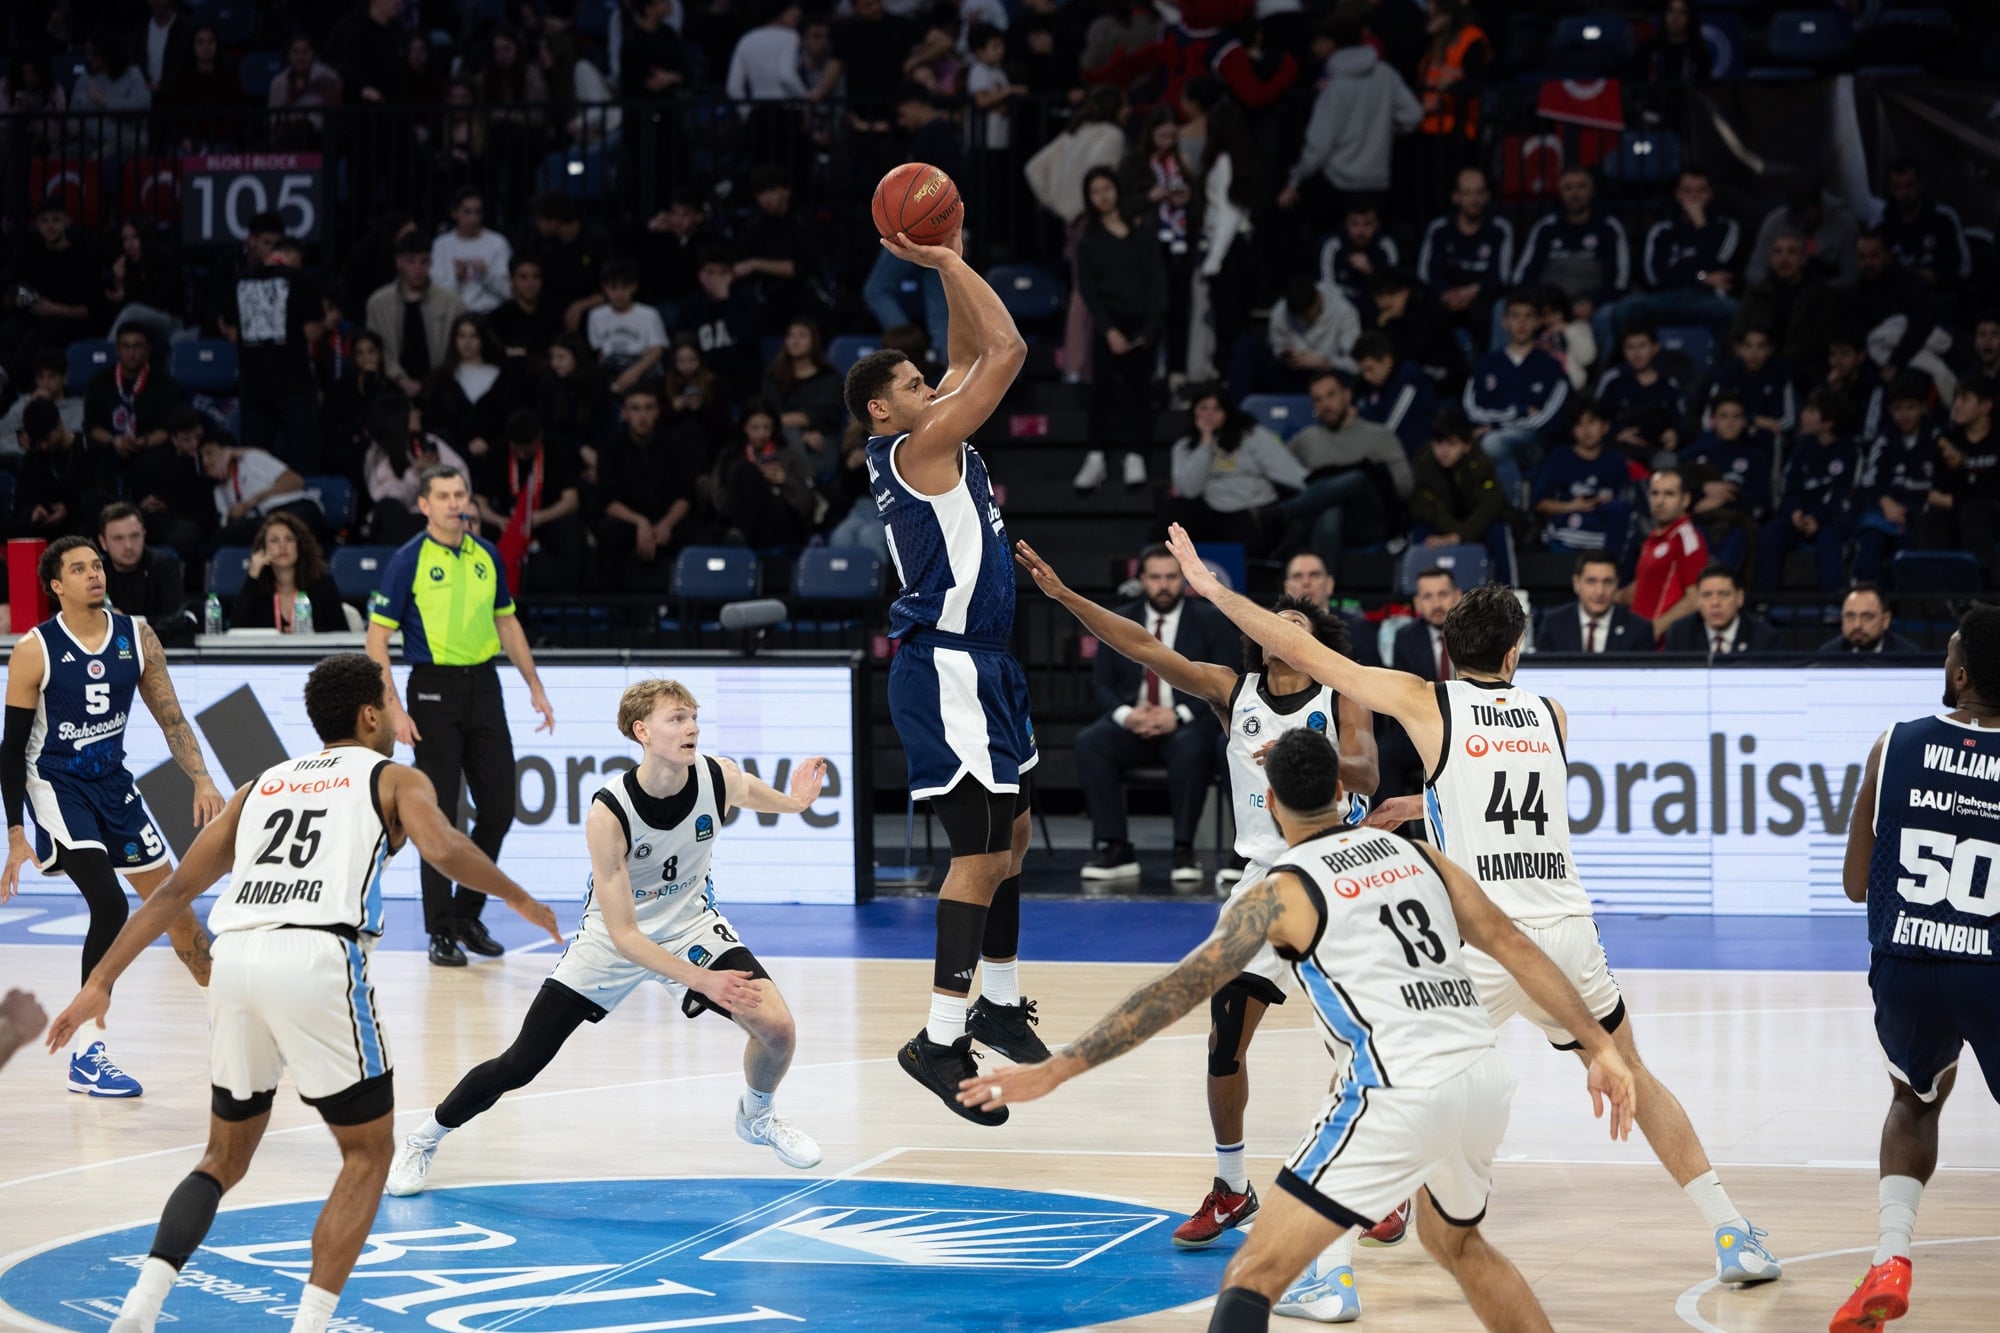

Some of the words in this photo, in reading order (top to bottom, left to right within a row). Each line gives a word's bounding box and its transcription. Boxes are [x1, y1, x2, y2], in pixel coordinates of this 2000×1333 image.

[192, 174, 315, 240] 105
[85, 683, 110, 715] 5
[1492, 740, 1551, 753] VEOLIA
[1923, 743, 2000, 783] WILLIAM
[289, 777, 350, 794] VEOLIA
[1567, 732, 1862, 836] oralisv
[1909, 788, 1953, 811] BAU
[1485, 771, 1548, 835] 44
[140, 823, 162, 856] 5
[254, 808, 328, 869] 25
[1321, 838, 1400, 874] BREUNIG
[662, 855, 678, 881] 8
[1359, 864, 1424, 889] VEOLIA
[1476, 852, 1567, 881] HAMBURG
[1897, 828, 2000, 917] 50
[1379, 899, 1446, 968] 13
[1892, 911, 1992, 955] İSTANBUL
